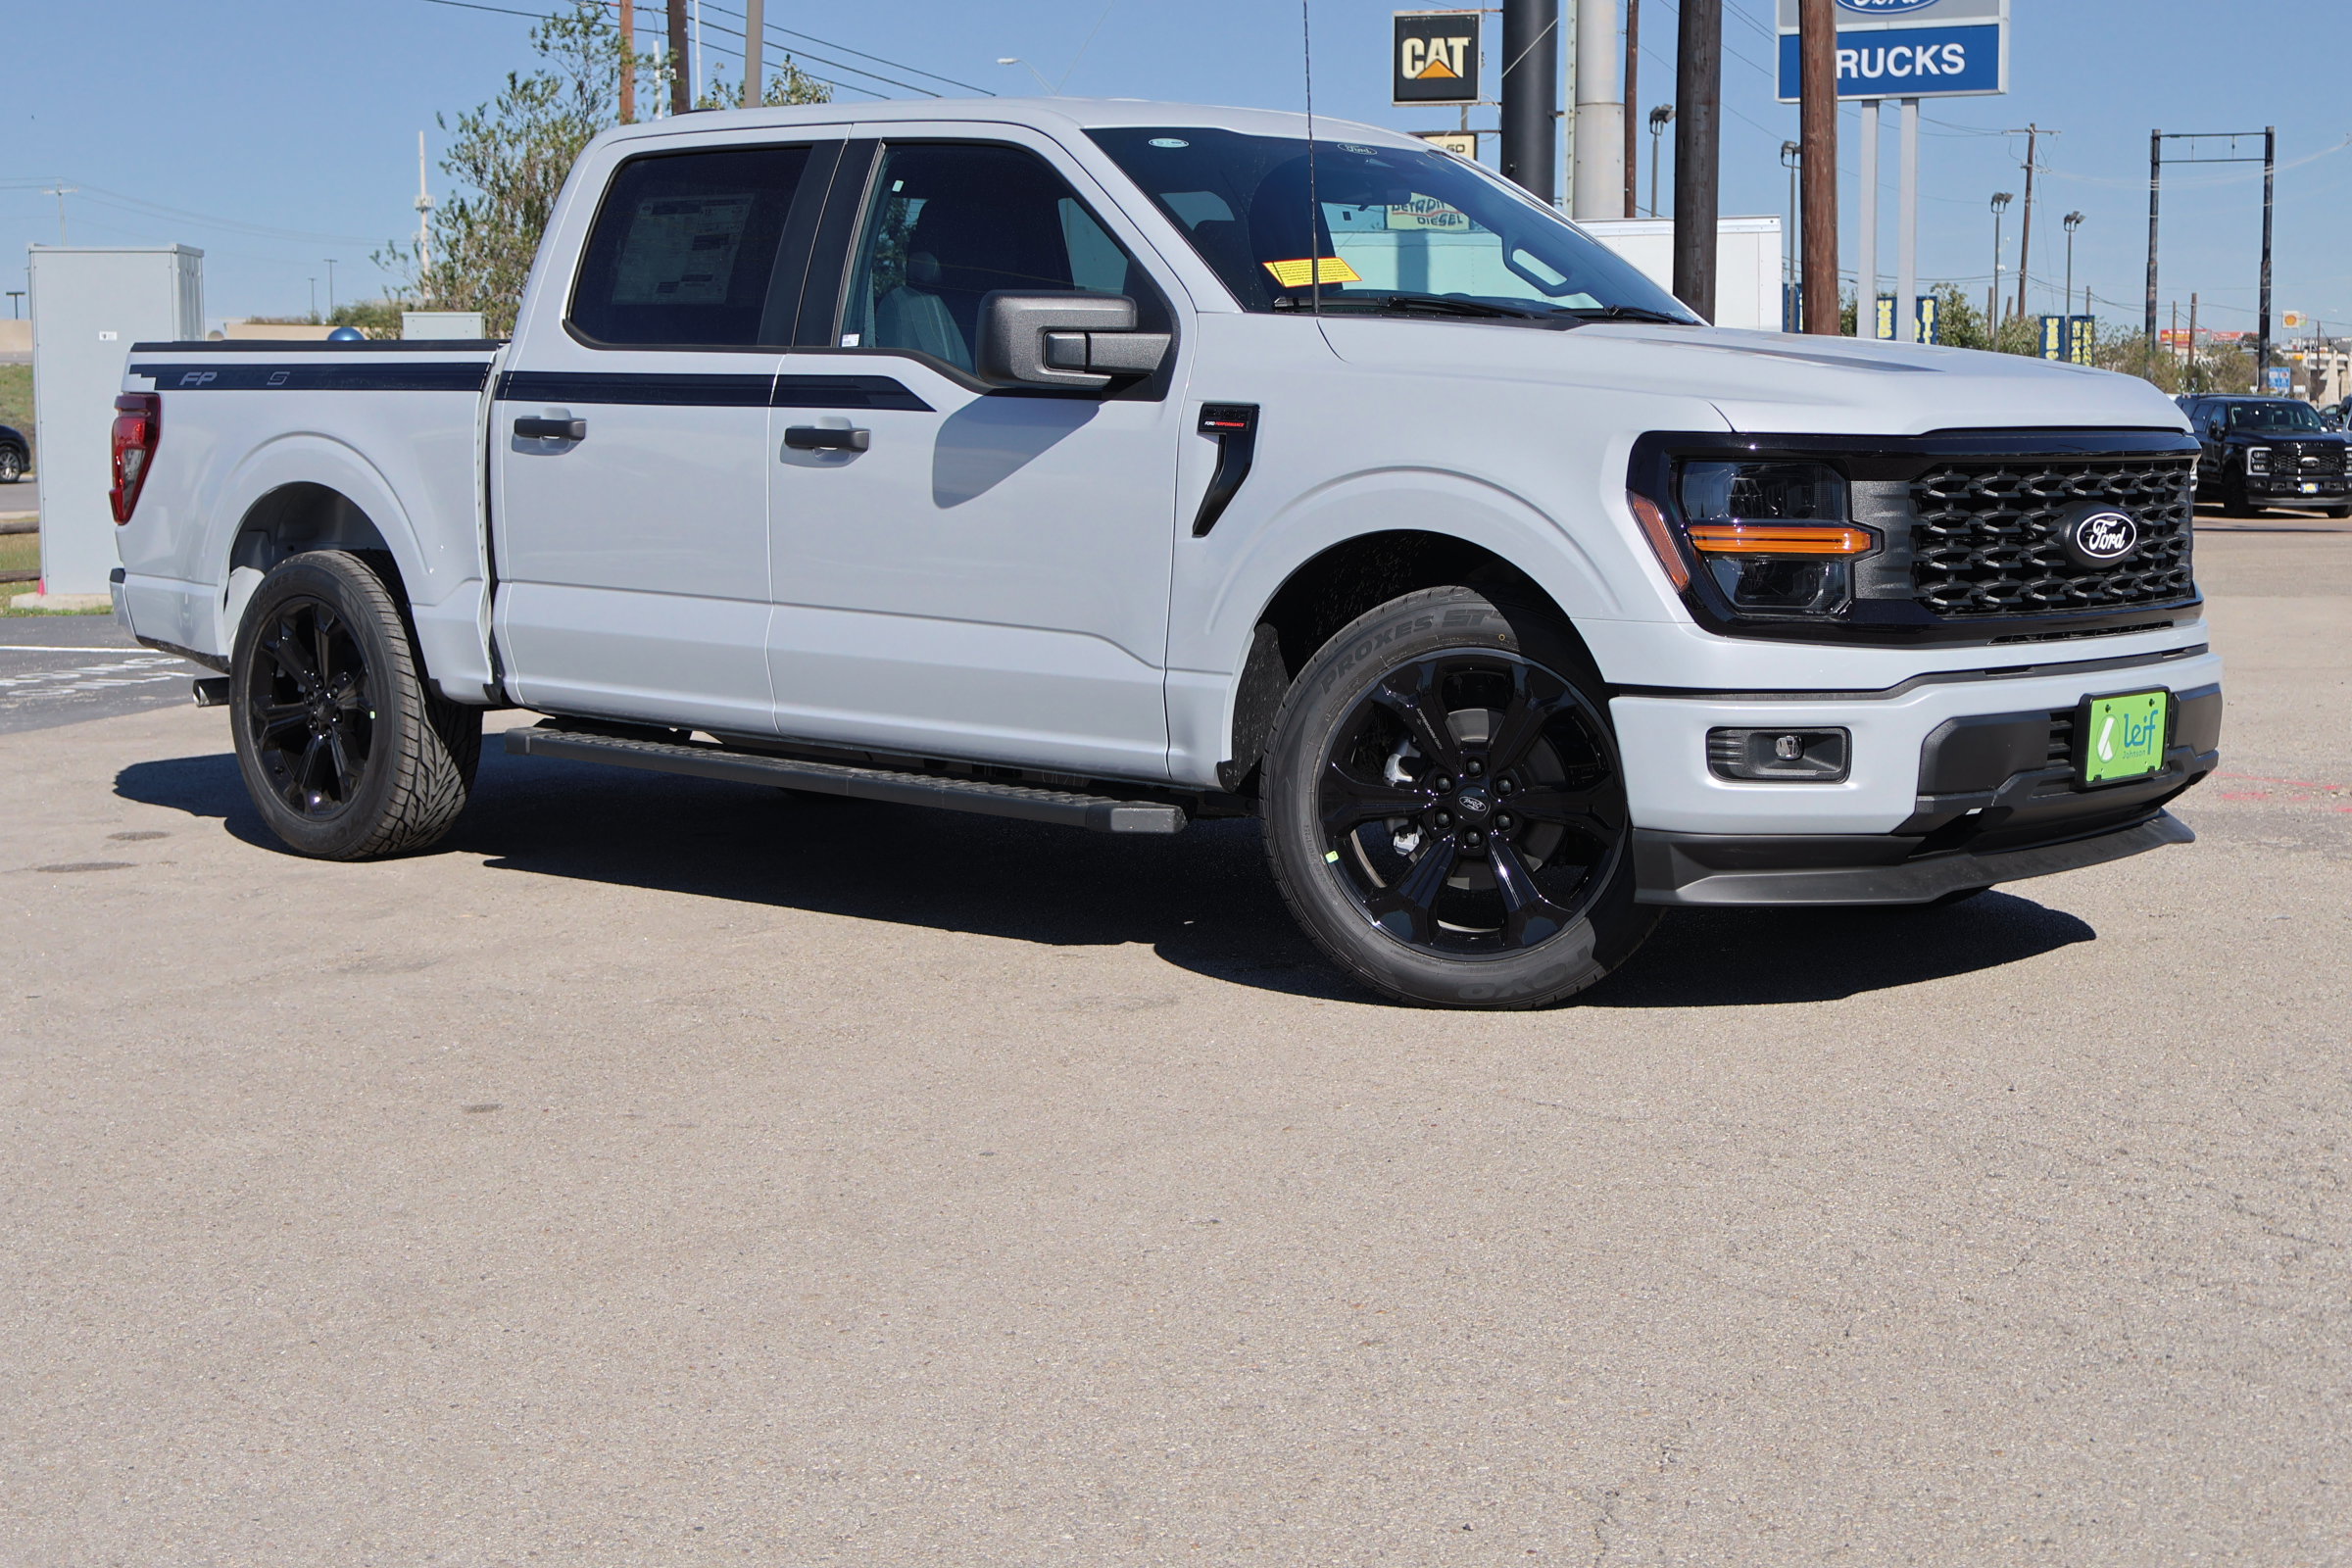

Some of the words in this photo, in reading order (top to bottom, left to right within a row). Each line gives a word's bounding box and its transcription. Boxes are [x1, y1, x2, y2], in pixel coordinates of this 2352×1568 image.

[1402, 36, 1470, 79] CAT
[1836, 43, 1966, 79] RUCKS
[1417, 213, 1463, 226] DIESEL
[2089, 519, 2126, 550] Ford
[1321, 614, 1434, 695] PROXES
[2123, 750, 2146, 760] Johnson
